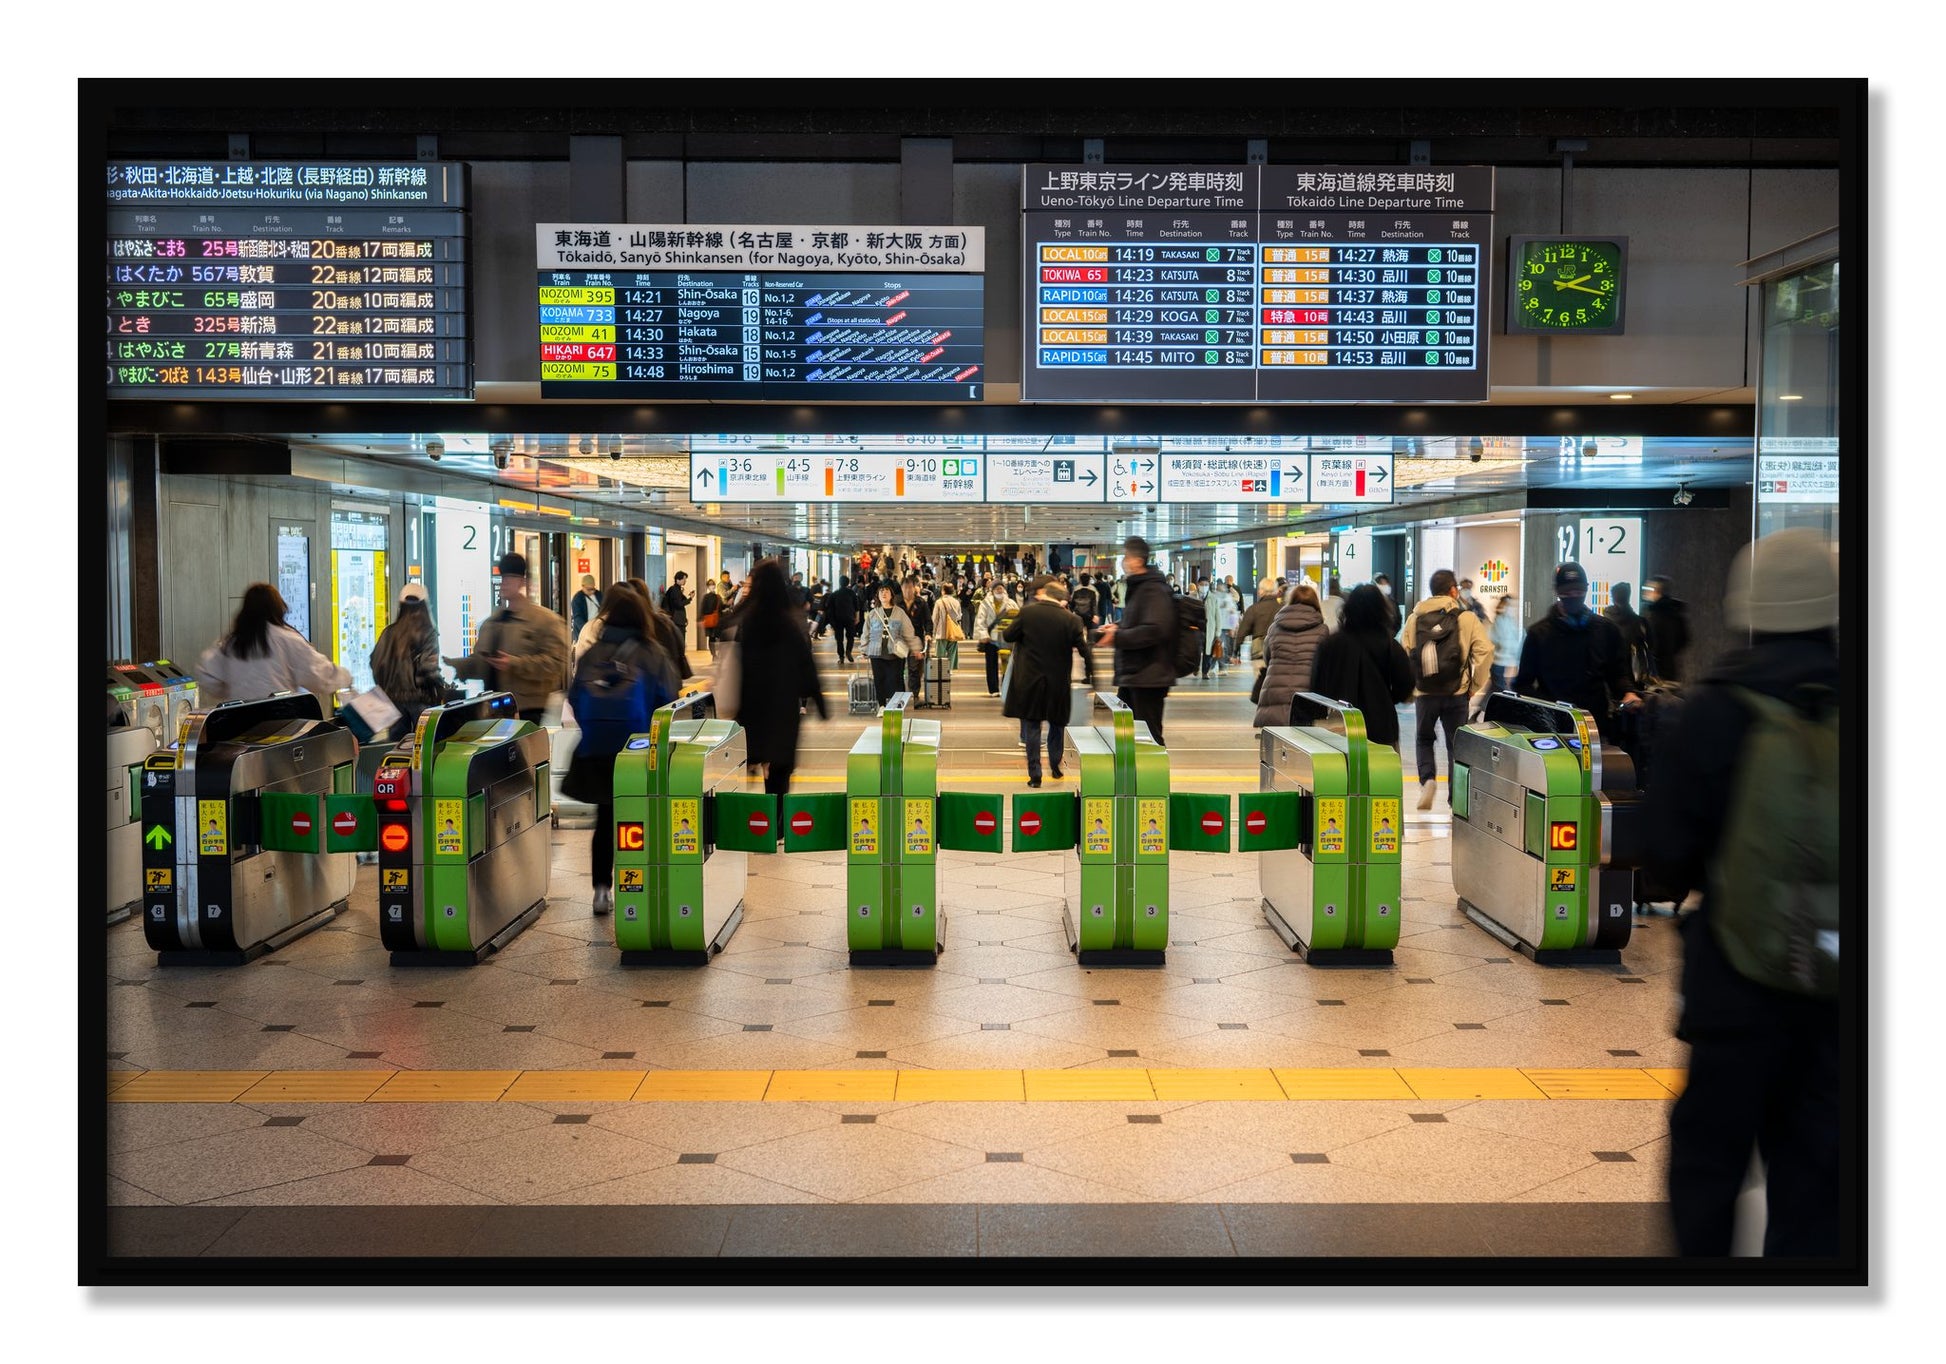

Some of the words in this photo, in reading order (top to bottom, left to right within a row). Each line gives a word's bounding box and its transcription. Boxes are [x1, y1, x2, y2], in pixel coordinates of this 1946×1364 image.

[1041, 171, 1243, 192] 上野東京ライン発車時刻
[1297, 172, 1455, 193] 東海道線発車時刻
[305, 189, 323, 200] (via
[326, 189, 368, 201] Nagano)
[371, 189, 428, 200] Shinkansen
[1041, 195, 1115, 209] Ueno-Tōkyō
[1118, 195, 1143, 206] Line
[1147, 196, 1211, 208] Departure
[1214, 196, 1244, 207] Time
[1286, 196, 1335, 207] Tōkaidō
[1339, 196, 1365, 207] Line
[1368, 197, 1431, 209] Departure
[1434, 197, 1464, 208] Time
[1054, 230, 1072, 238] Type
[202, 240, 238, 257] 25号
[311, 240, 362, 259] 20番線
[363, 241, 433, 258] 17両編成
[1043, 249, 1081, 260] LOCAL
[1115, 248, 1154, 261] 14:19
[1161, 251, 1200, 259] TAKASAKI
[1272, 248, 1297, 262] 普通
[1337, 249, 1376, 262] 14:27
[1382, 249, 1409, 263] 熱海
[1560, 247, 1575, 259] 12
[557, 251, 617, 264] Tōkaidō,
[620, 251, 661, 266] Sanyō
[665, 251, 743, 264] Shinkansen
[749, 252, 775, 266] (for
[777, 253, 833, 267] Nagoya,
[837, 252, 881, 267] Kyōto,
[885, 252, 965, 266] Shin-Ōsaka)
[1544, 252, 1558, 263] 11
[115, 266, 183, 282] はくたか
[192, 267, 239, 282] 567号
[239, 265, 275, 283] 敦賀
[1530, 263, 1545, 274] 10
[1043, 270, 1082, 280] TOKIWA
[1087, 270, 1101, 280] 65
[1115, 269, 1154, 282] 14:23
[1161, 270, 1199, 280] KATSUTA
[1337, 270, 1375, 282] 14:30
[1382, 269, 1408, 283] 品川
[1521, 280, 1533, 291] 9
[1600, 280, 1610, 291] 3
[117, 291, 184, 307] やまびこ
[204, 292, 240, 307] 65号
[239, 291, 275, 309] 盛岡
[541, 289, 583, 299] NOZOMI
[586, 290, 612, 303] 395
[625, 290, 661, 303] 14:21
[678, 288, 737, 299] Shin-Ōsaka
[743, 291, 759, 304] 16
[765, 294, 795, 304] No.1,2
[1043, 290, 1081, 300] RAPID
[1115, 289, 1154, 302] 14:26
[1161, 290, 1199, 300] KATSUTA
[1336, 290, 1375, 303] 14:37
[1381, 290, 1408, 303] 熱海
[541, 308, 584, 317] KODAMA
[586, 309, 613, 322] 733
[625, 309, 663, 323] 14:27
[678, 308, 720, 319] Nagoya
[744, 310, 759, 323] 19
[1043, 311, 1081, 321] LOCAL
[1115, 310, 1154, 322] 14:29
[1160, 311, 1199, 321] KOGA
[1271, 310, 1296, 323] 特急
[1303, 311, 1328, 323] 10両
[1336, 310, 1374, 323] 14:43
[1381, 310, 1407, 324] 品川
[1445, 311, 1471, 324] 10番線
[1559, 312, 1570, 323] 6
[118, 317, 151, 333] とき
[194, 317, 240, 333] 325号
[240, 316, 276, 335] 新潟
[542, 327, 584, 336] NOZOMI
[591, 328, 608, 340] 41
[625, 328, 664, 341] 14:30
[678, 327, 717, 337] Hakata
[744, 329, 759, 342] 18
[1043, 331, 1081, 342] LOCAL
[1114, 330, 1153, 343] 14:39
[1161, 333, 1199, 341] TAKASAKI
[1336, 331, 1374, 344] 14:50
[1381, 330, 1419, 344] 小田原
[118, 342, 185, 358] はやぶさ
[205, 343, 240, 358] 27号
[240, 341, 294, 360] 新青森
[544, 345, 583, 355] HIKARI
[587, 347, 614, 359] 647
[626, 347, 664, 360] 14:33
[679, 345, 738, 356] Shin-Ōsaka
[744, 347, 759, 360] 15
[765, 350, 796, 359] No.1-5
[1043, 351, 1081, 362] RAPID
[1114, 351, 1153, 363] 14:45
[1161, 352, 1195, 362] MITO
[1270, 351, 1296, 364] 普通
[1335, 351, 1374, 364] 14:53
[1380, 351, 1406, 365] 品川
[196, 368, 241, 383] 143号
[543, 364, 585, 373] NOZOMI
[592, 365, 609, 378] 75
[626, 365, 665, 378] 14:48
[679, 363, 734, 374] Hiroshima
[745, 366, 759, 379] 19
[1321, 459, 1352, 470] 京葉線
[729, 474, 767, 482] 京浜東北線
[787, 474, 810, 482] 山手線
[835, 474, 886, 482] 上野東京ライン
[906, 474, 937, 482] 東海道線
[942, 479, 974, 489] 新幹線
[410, 517, 418, 560] 1
[463, 525, 477, 550] 2
[1345, 543, 1356, 560] 4
[1219, 553, 1227, 565] 6
[1480, 584, 1508, 593] GRANSTA
[377, 783, 395, 794] QR
[619, 826, 643, 849] IC
[1552, 826, 1576, 848] IC
[155, 907, 162, 915] 8
[393, 907, 399, 915] 7
[627, 907, 634, 916] 6
[681, 907, 688, 915] 5
[914, 907, 921, 915] 4
[1148, 907, 1155, 915] 3
[1380, 906, 1387, 915] 2
